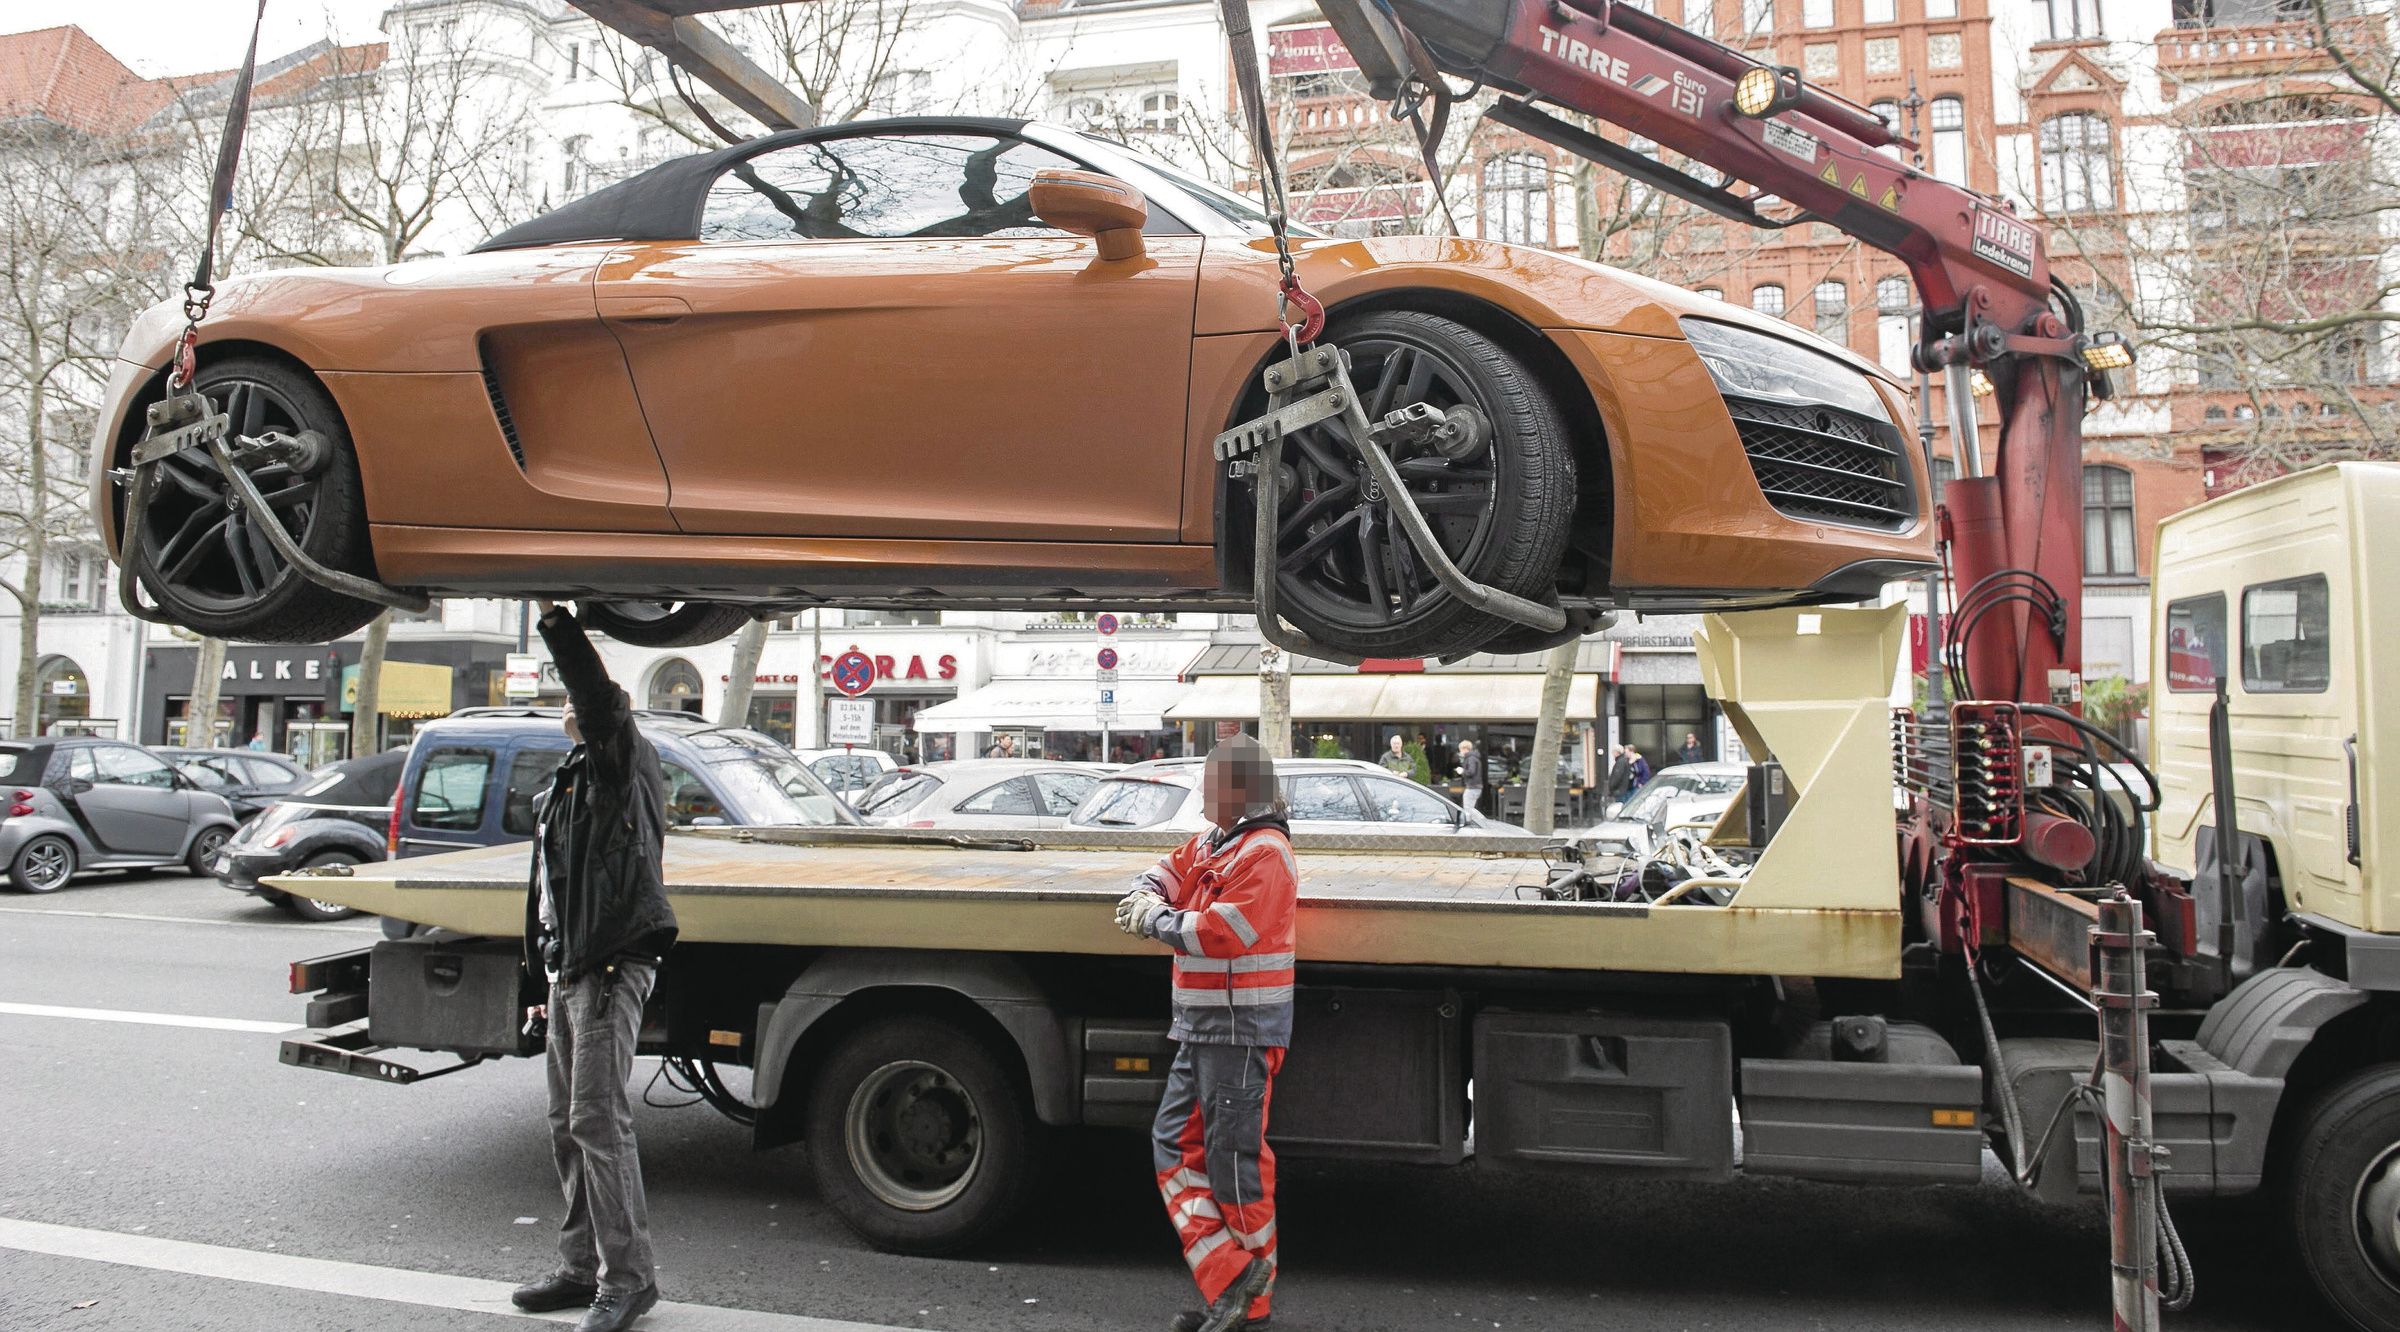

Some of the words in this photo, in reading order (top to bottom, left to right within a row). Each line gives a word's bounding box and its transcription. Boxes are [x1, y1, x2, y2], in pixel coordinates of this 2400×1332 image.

[1539, 25, 1630, 86] TIRRE
[1673, 70, 1707, 96] Euro
[1671, 84, 1704, 119] 131
[1980, 211, 2032, 256] TIRRE
[1976, 237, 2030, 274] Ladekrane
[221, 660, 320, 680] ALKE
[813, 655, 957, 680] CRAS
